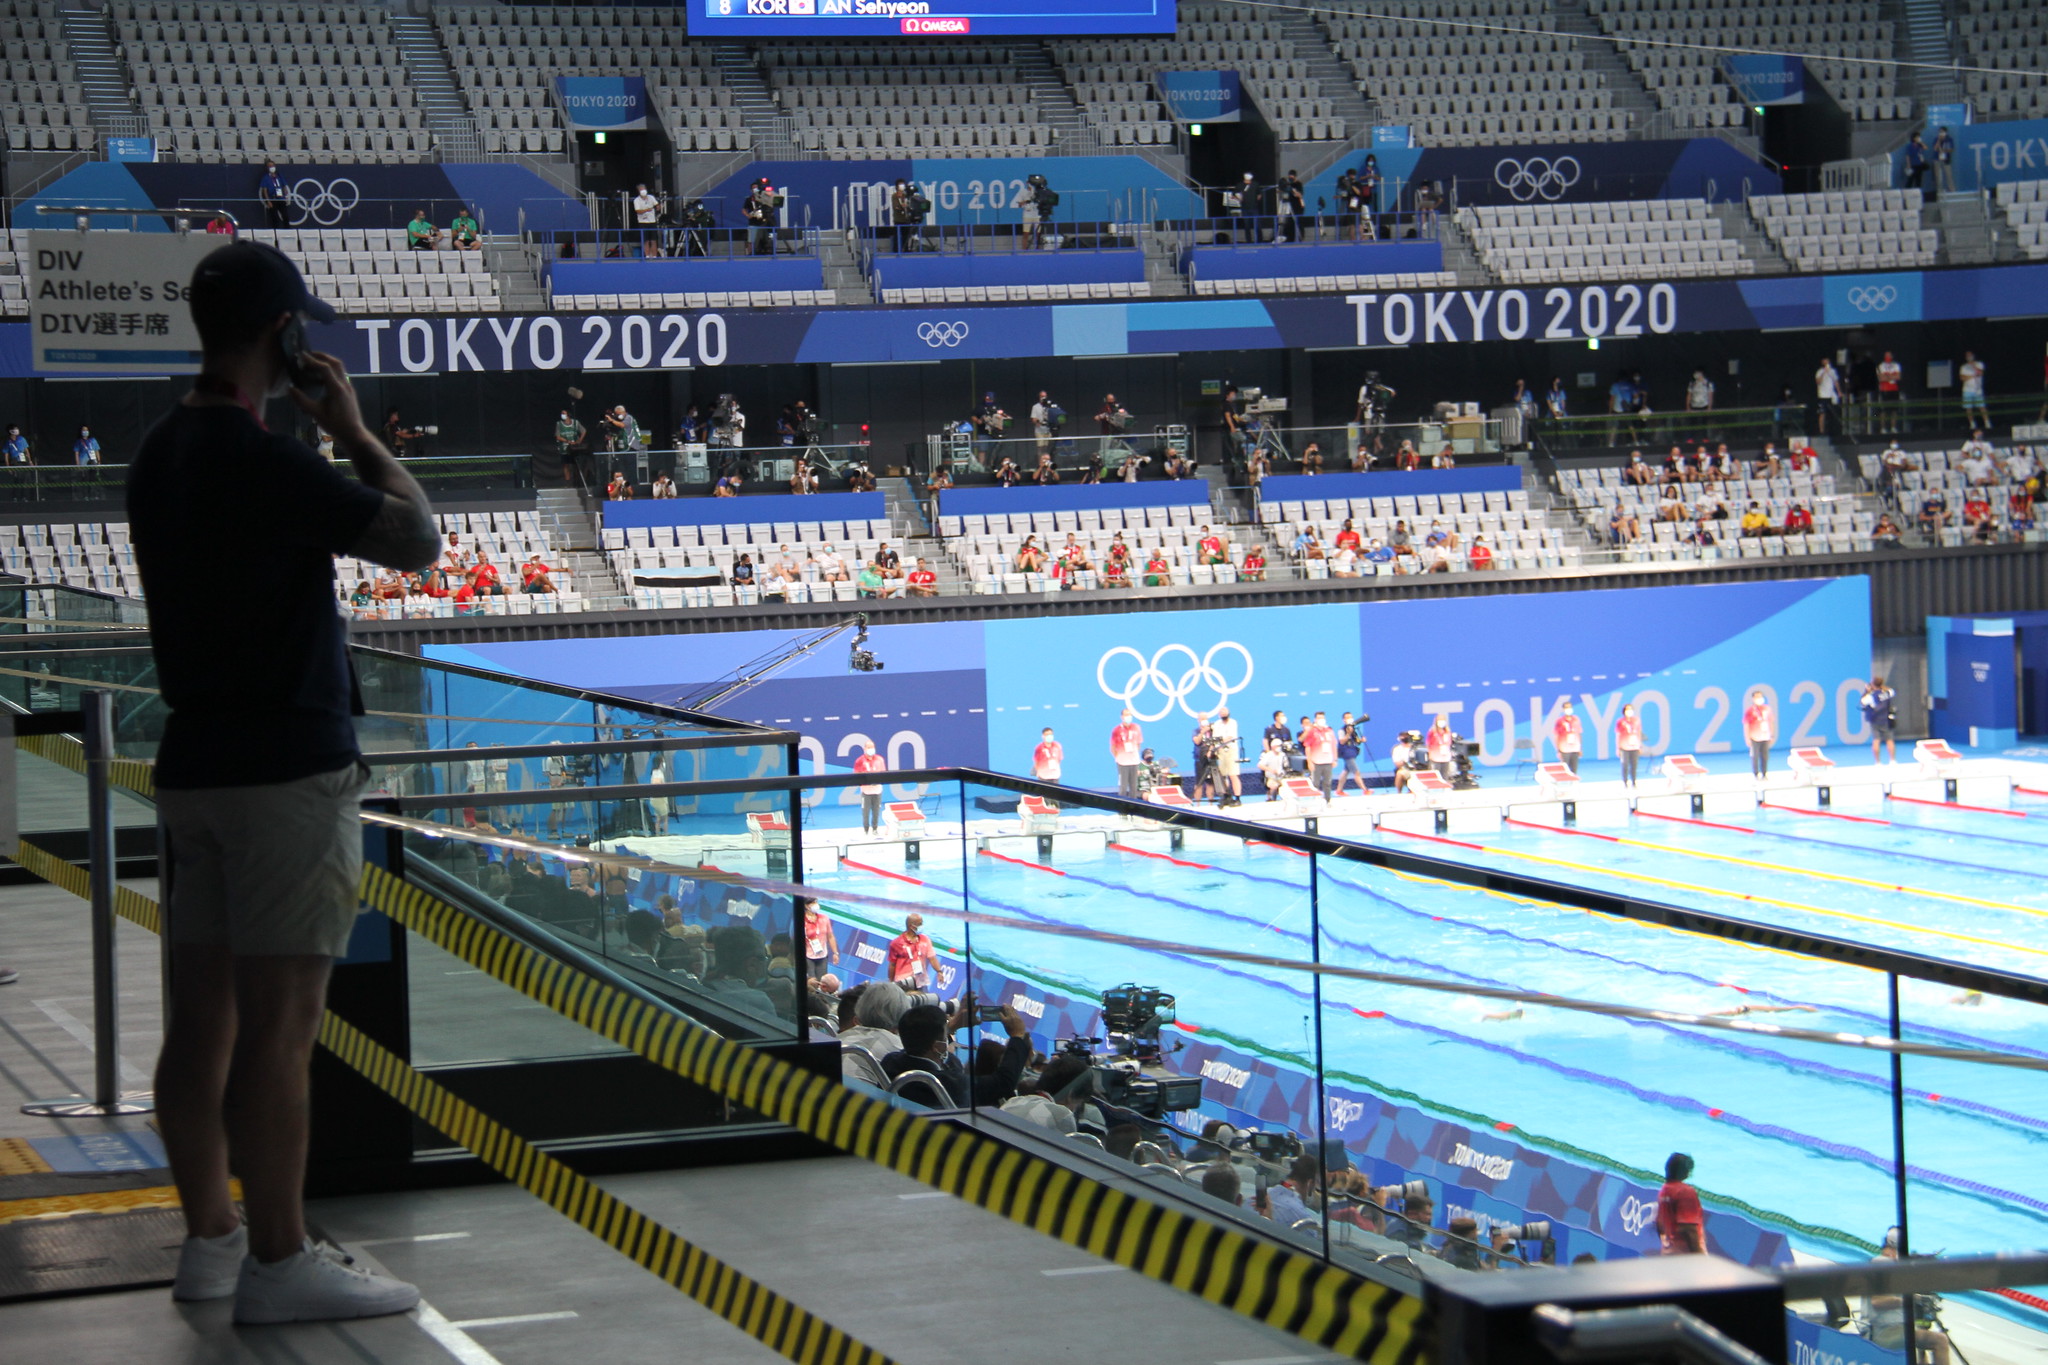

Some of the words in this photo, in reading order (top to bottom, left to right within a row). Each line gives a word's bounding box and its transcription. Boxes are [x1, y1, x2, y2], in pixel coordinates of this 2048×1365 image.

[719, 0, 732, 15] 8
[747, 0, 788, 14] KOR
[822, 0, 852, 14] AN
[856, 0, 929, 18] Sehyeon
[921, 20, 965, 32] OMEGA
[564, 95, 604, 107] TOKYO
[607, 95, 636, 107] 2020
[1203, 89, 1231, 100] 2020
[38, 250, 83, 271] DIV
[38, 279, 154, 301] Athlete's
[40, 312, 170, 336] DIV選手席
[1345, 289, 1529, 346] TOKYO
[1544, 283, 1677, 339] 2020
[355, 316, 563, 373] TOKYO
[581, 313, 728, 369] 2020
